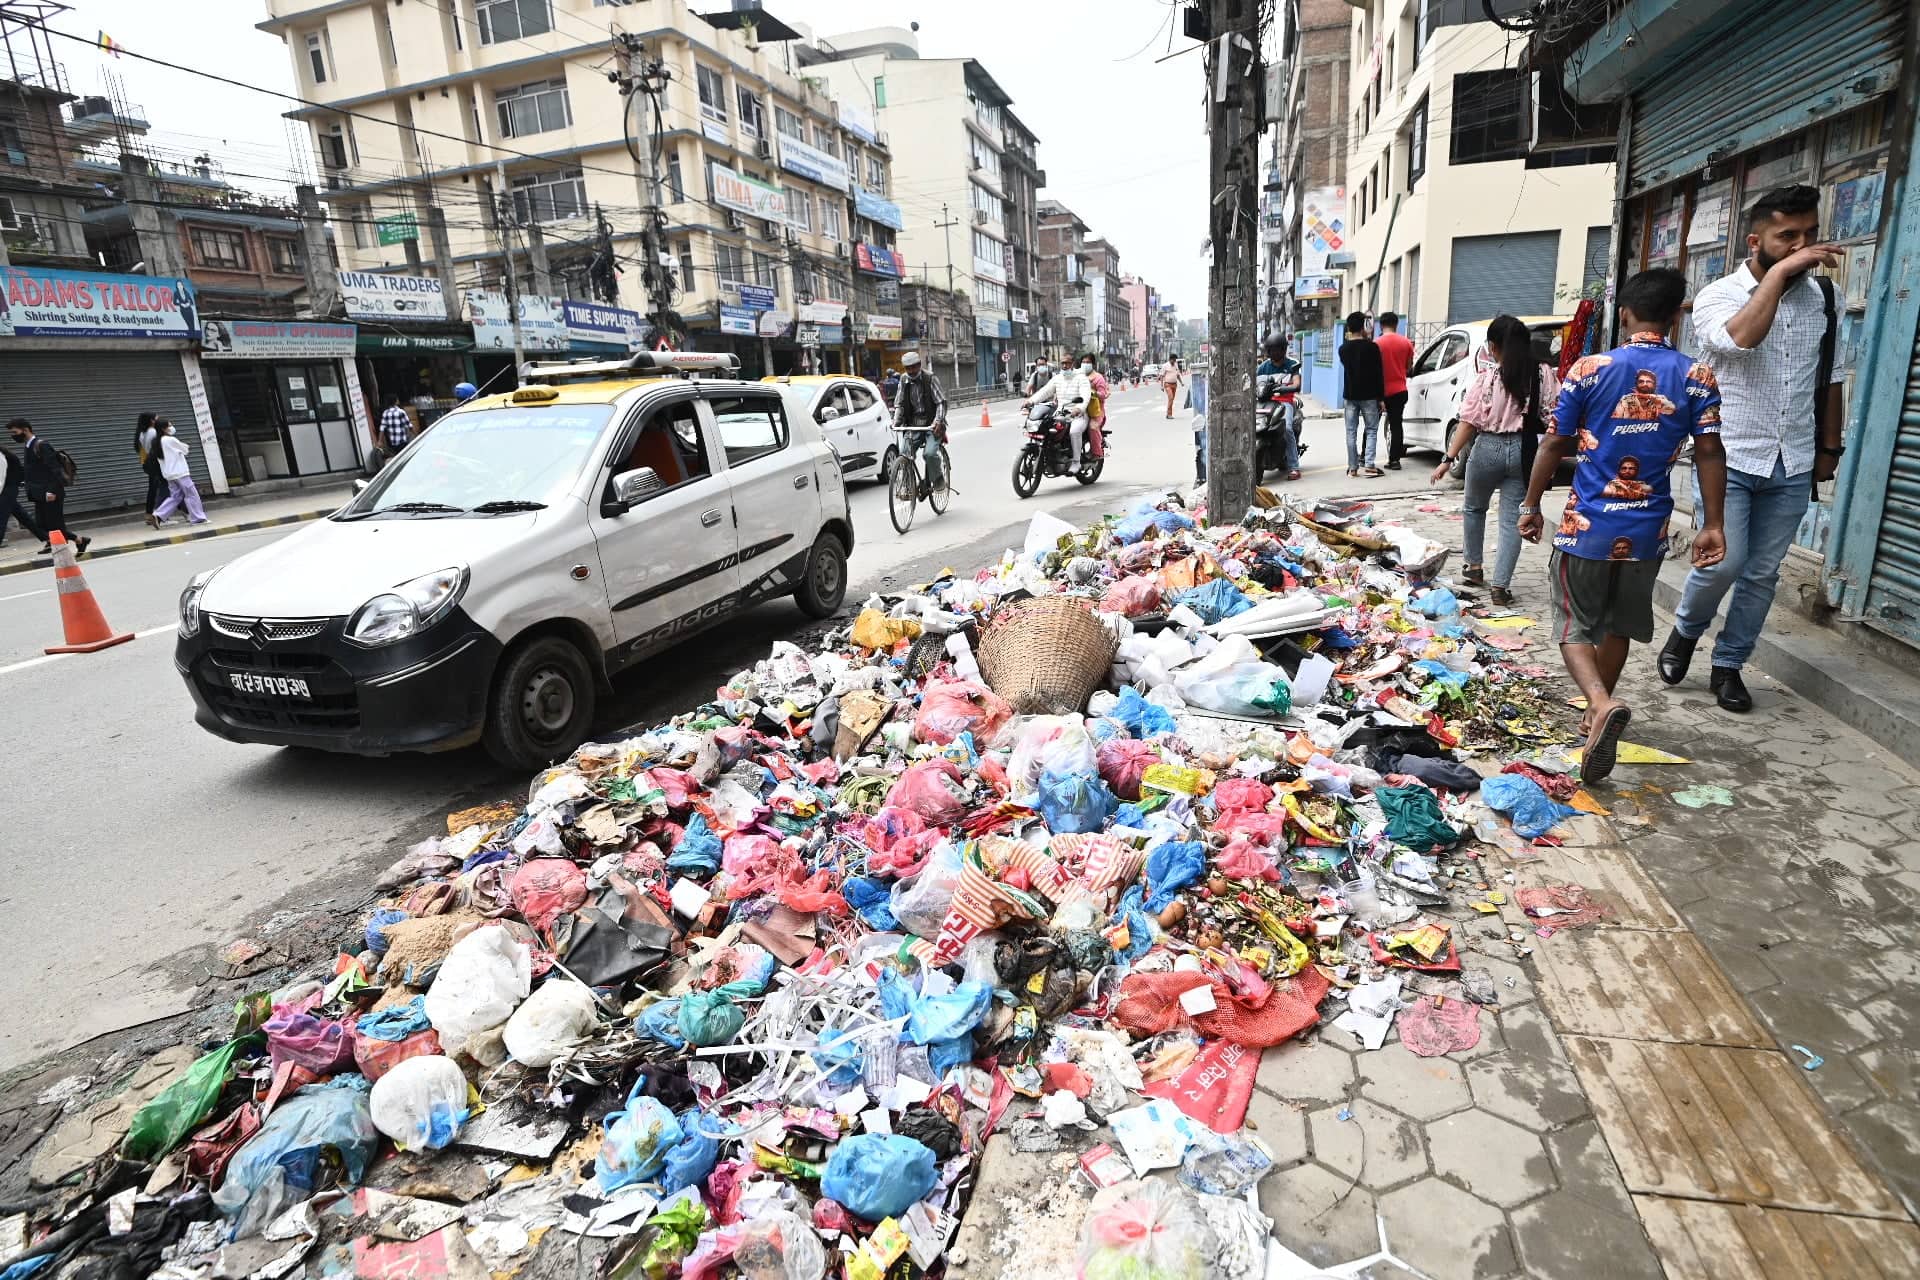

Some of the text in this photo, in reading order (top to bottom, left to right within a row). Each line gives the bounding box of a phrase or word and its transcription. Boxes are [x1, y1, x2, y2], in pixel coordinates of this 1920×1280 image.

[716, 175, 753, 206] CIMA
[340, 271, 442, 293] UMA TRADERS
[8, 277, 177, 313] ADAMS TAILOR
[24, 311, 165, 326] Shirting Suting & Readymade
[568, 306, 637, 330] TIME SUPPLIERS
[382, 337, 454, 347] UMA TRADERS
[1612, 422, 1660, 436] PUSHPA
[1603, 499, 1649, 513] PUSHPA
[630, 596, 737, 651] adidas
